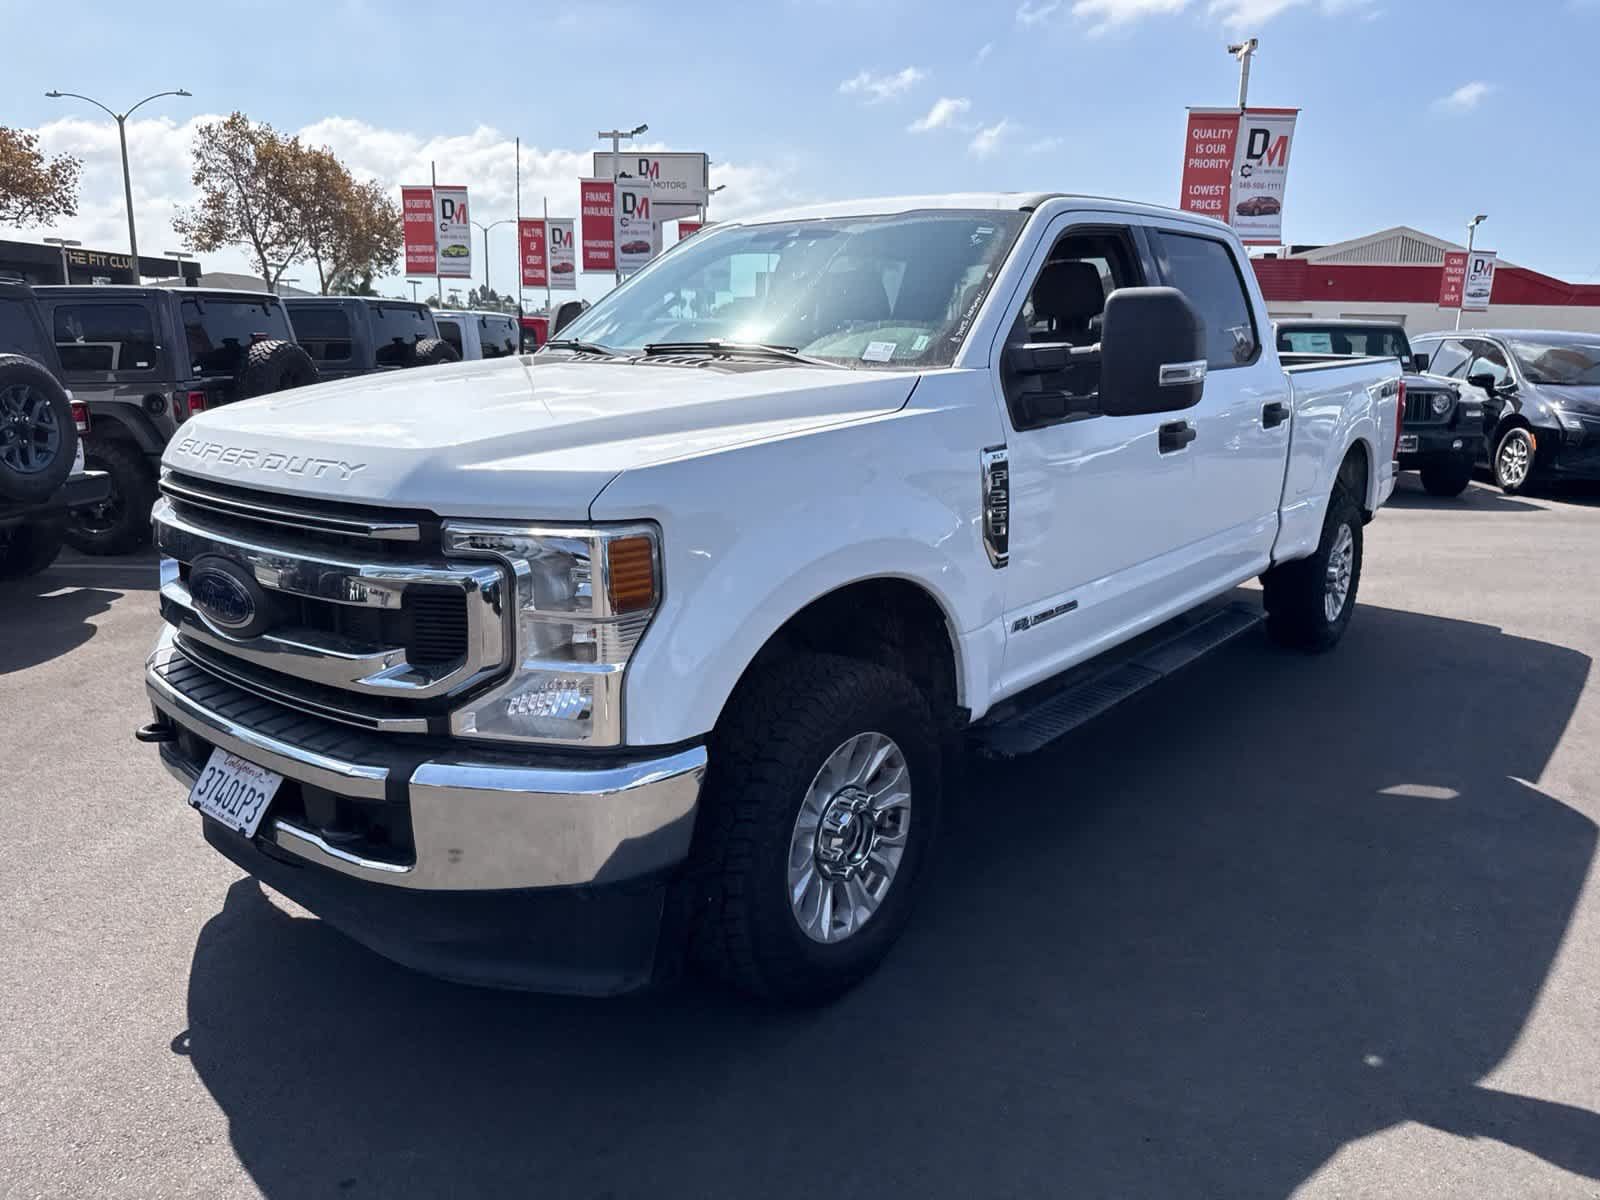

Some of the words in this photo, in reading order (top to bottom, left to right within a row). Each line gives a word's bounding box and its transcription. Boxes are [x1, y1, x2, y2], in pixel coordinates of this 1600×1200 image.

[1192, 128, 1233, 141] QUALITY
[1195, 143, 1205, 154] IS
[1205, 143, 1226, 154] OUR
[1246, 128, 1288, 167] DM
[1188, 158, 1231, 169] PRIORITY
[585, 191, 610, 202] FINANCE
[1189, 184, 1225, 196] LOWEST
[622, 191, 649, 220] DM
[1190, 199, 1222, 210] PRICES
[441, 198, 467, 225] DM
[583, 206, 614, 217] AVAILABLE
[88, 252, 107, 267] FIT
[176, 437, 259, 469] SUPER
[260, 451, 367, 481] DUTY
[197, 766, 266, 824] 37401P3
